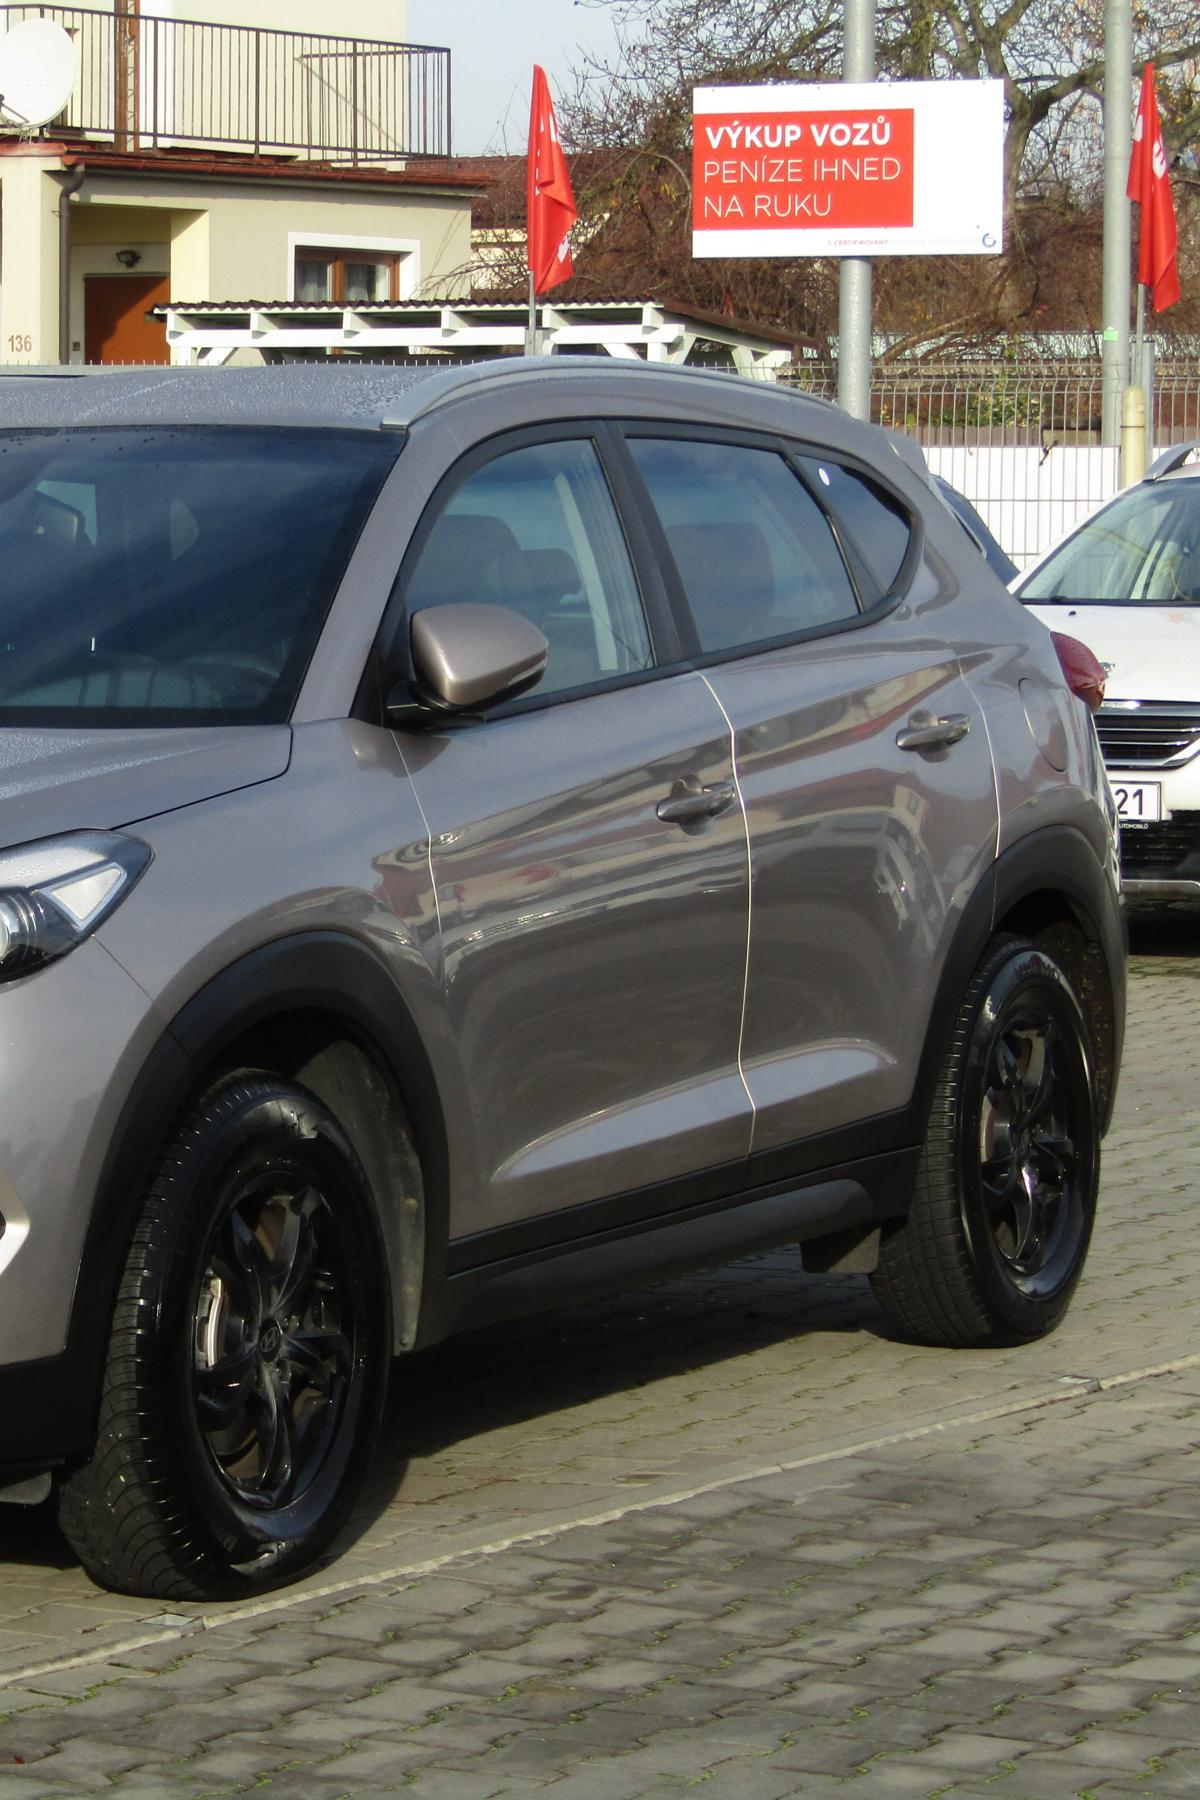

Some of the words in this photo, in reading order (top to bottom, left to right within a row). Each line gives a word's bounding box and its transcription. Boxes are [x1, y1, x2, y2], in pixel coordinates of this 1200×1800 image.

[705, 120, 801, 149] VÝKUP
[810, 115, 891, 147] VOZŮ
[704, 155, 802, 183] PENÍZE
[813, 157, 901, 181] IHNED
[704, 195, 744, 218] NA
[754, 193, 832, 217] RUKU
[8, 334, 32, 352] 136
[1115, 788, 1143, 816] 21
